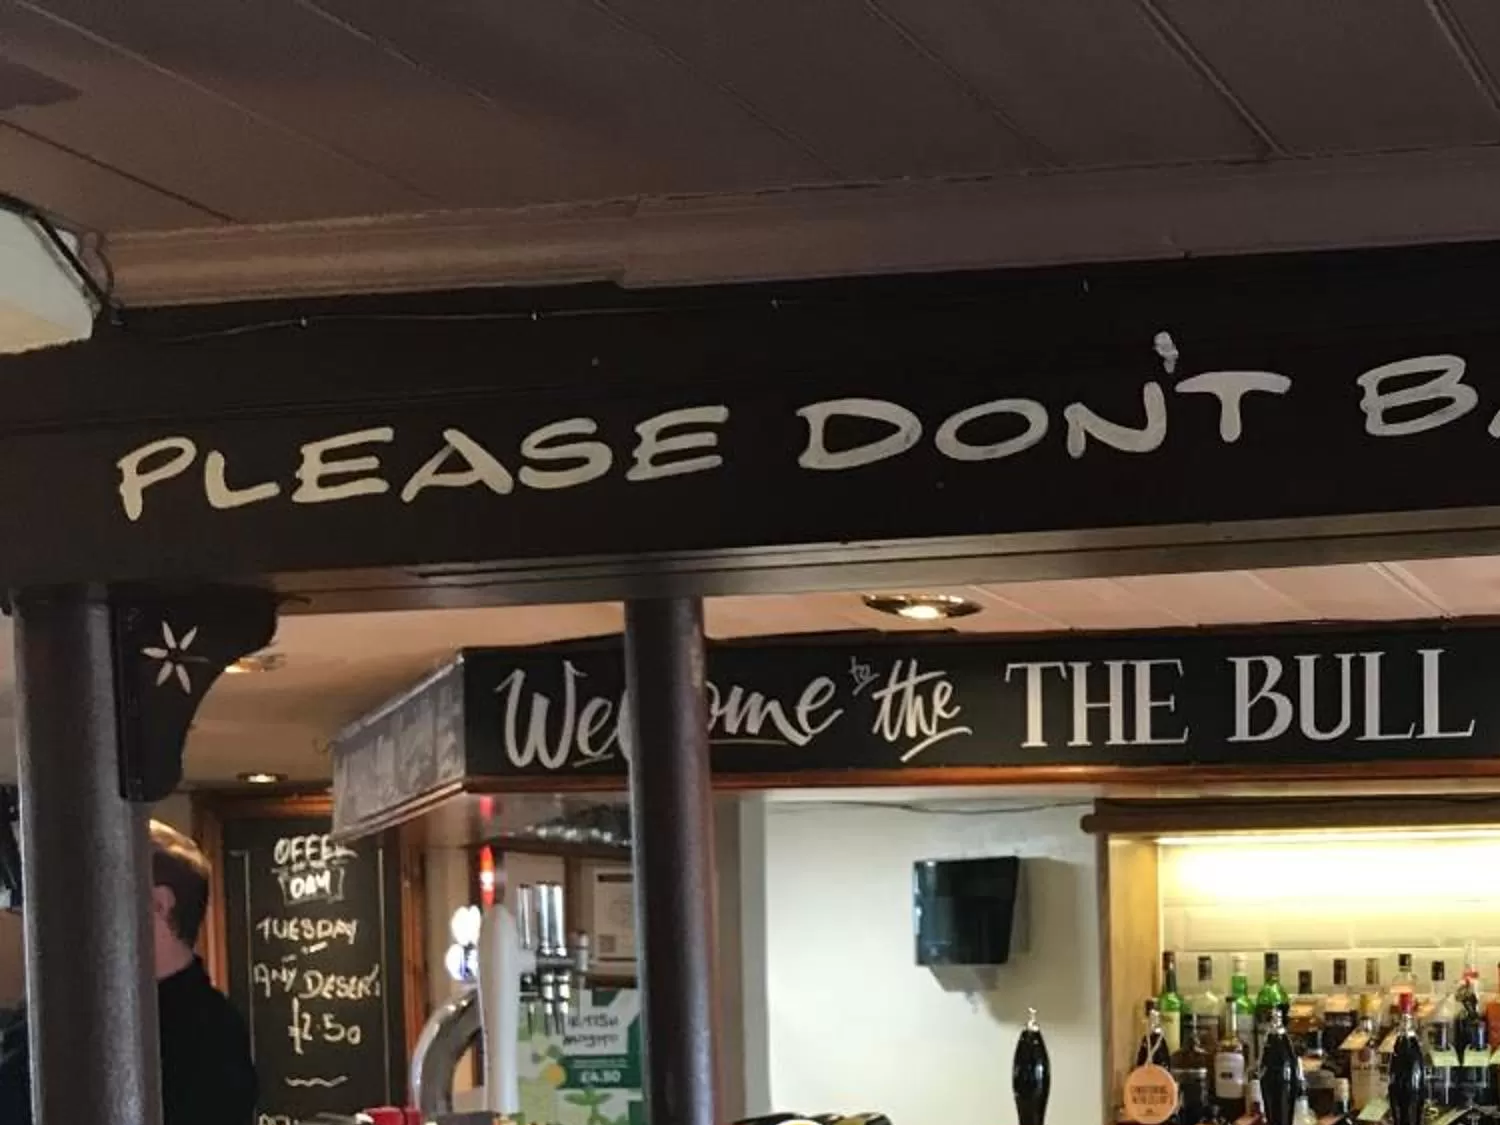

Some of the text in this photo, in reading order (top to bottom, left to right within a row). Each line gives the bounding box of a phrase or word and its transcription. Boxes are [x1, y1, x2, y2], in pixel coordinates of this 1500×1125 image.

[117, 405, 729, 521] PLEASE
[796, 331, 1291, 470] DON'T
[495, 660, 844, 769] Weme
[872, 658, 961, 742] the
[1005, 659, 1189, 748] THE
[1226, 649, 1475, 743] BULL
[257, 917, 358, 944] TUESDAY
